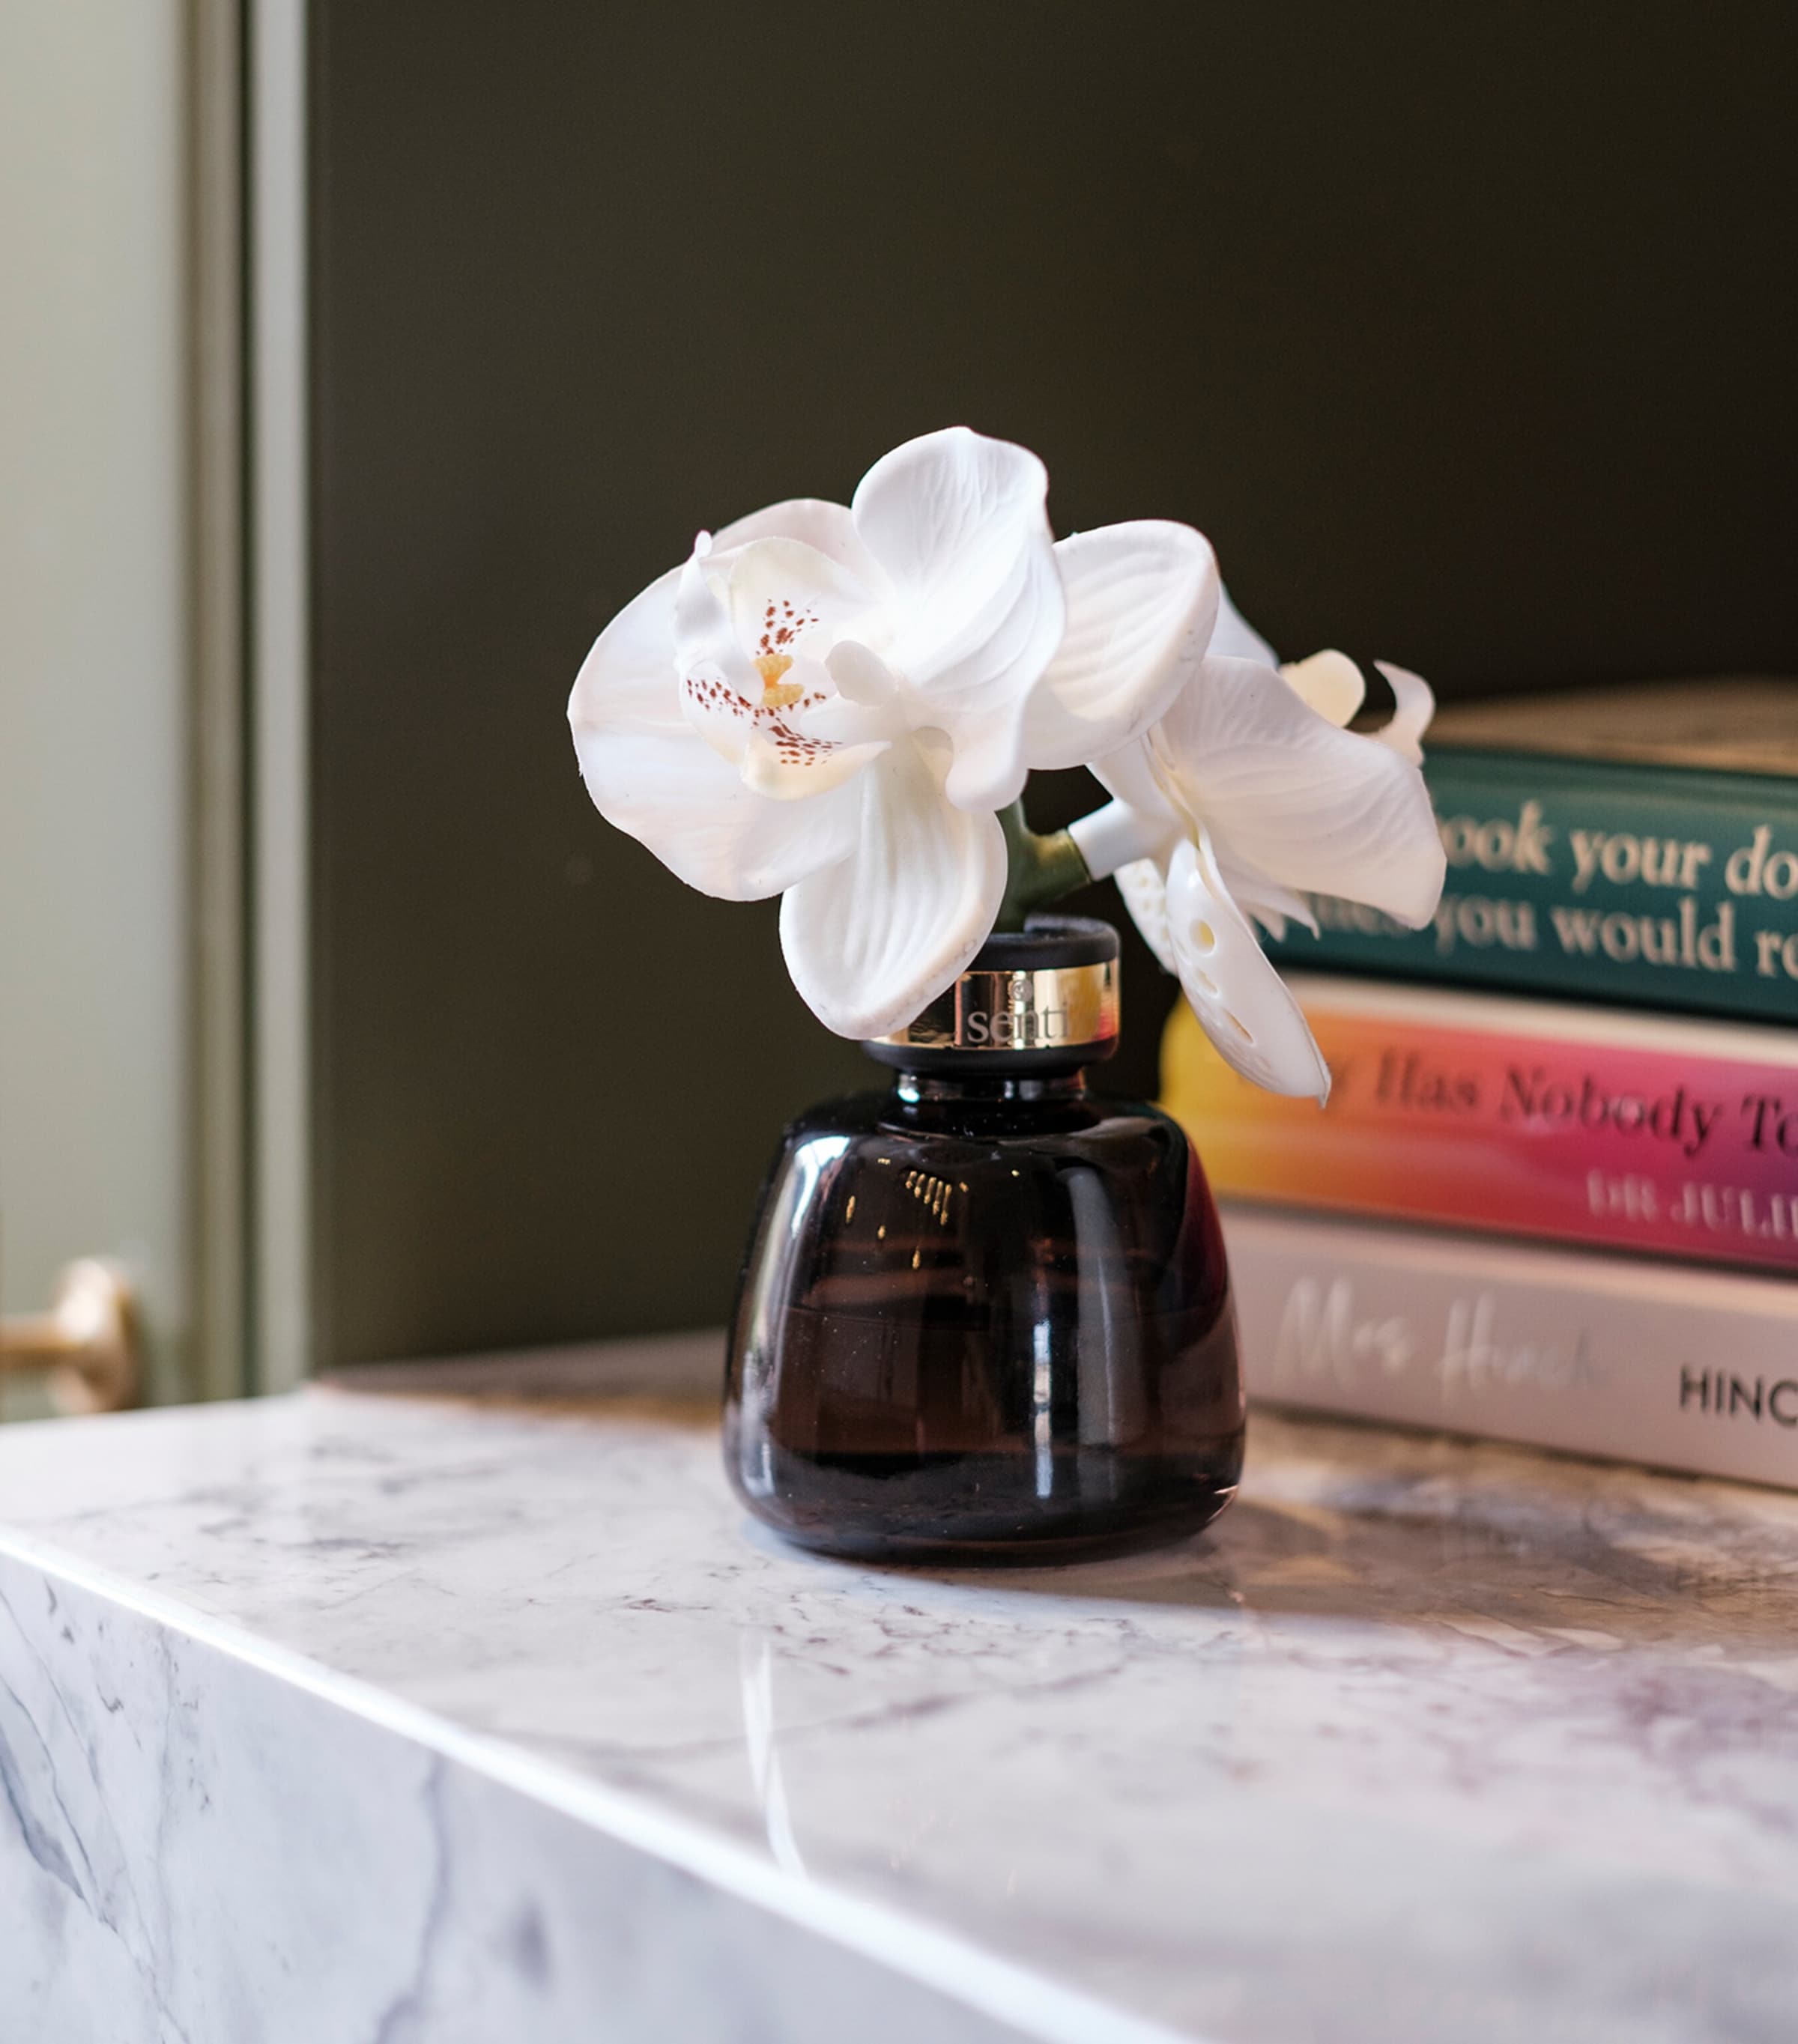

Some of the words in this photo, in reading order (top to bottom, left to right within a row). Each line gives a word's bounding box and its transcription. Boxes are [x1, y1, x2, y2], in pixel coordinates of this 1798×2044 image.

[1436, 800, 1552, 876] ook
[1570, 828, 1711, 894] your
[1725, 825, 1798, 900] do
[1435, 892, 1538, 956] you
[1551, 897, 1736, 971] would
[967, 1001, 1070, 1043] senti
[1375, 1046, 1479, 1110] Has
[1499, 1061, 1725, 1158] Nobody
[1670, 1180, 1798, 1240] JULI
[1679, 1363, 1798, 1429] HINC
